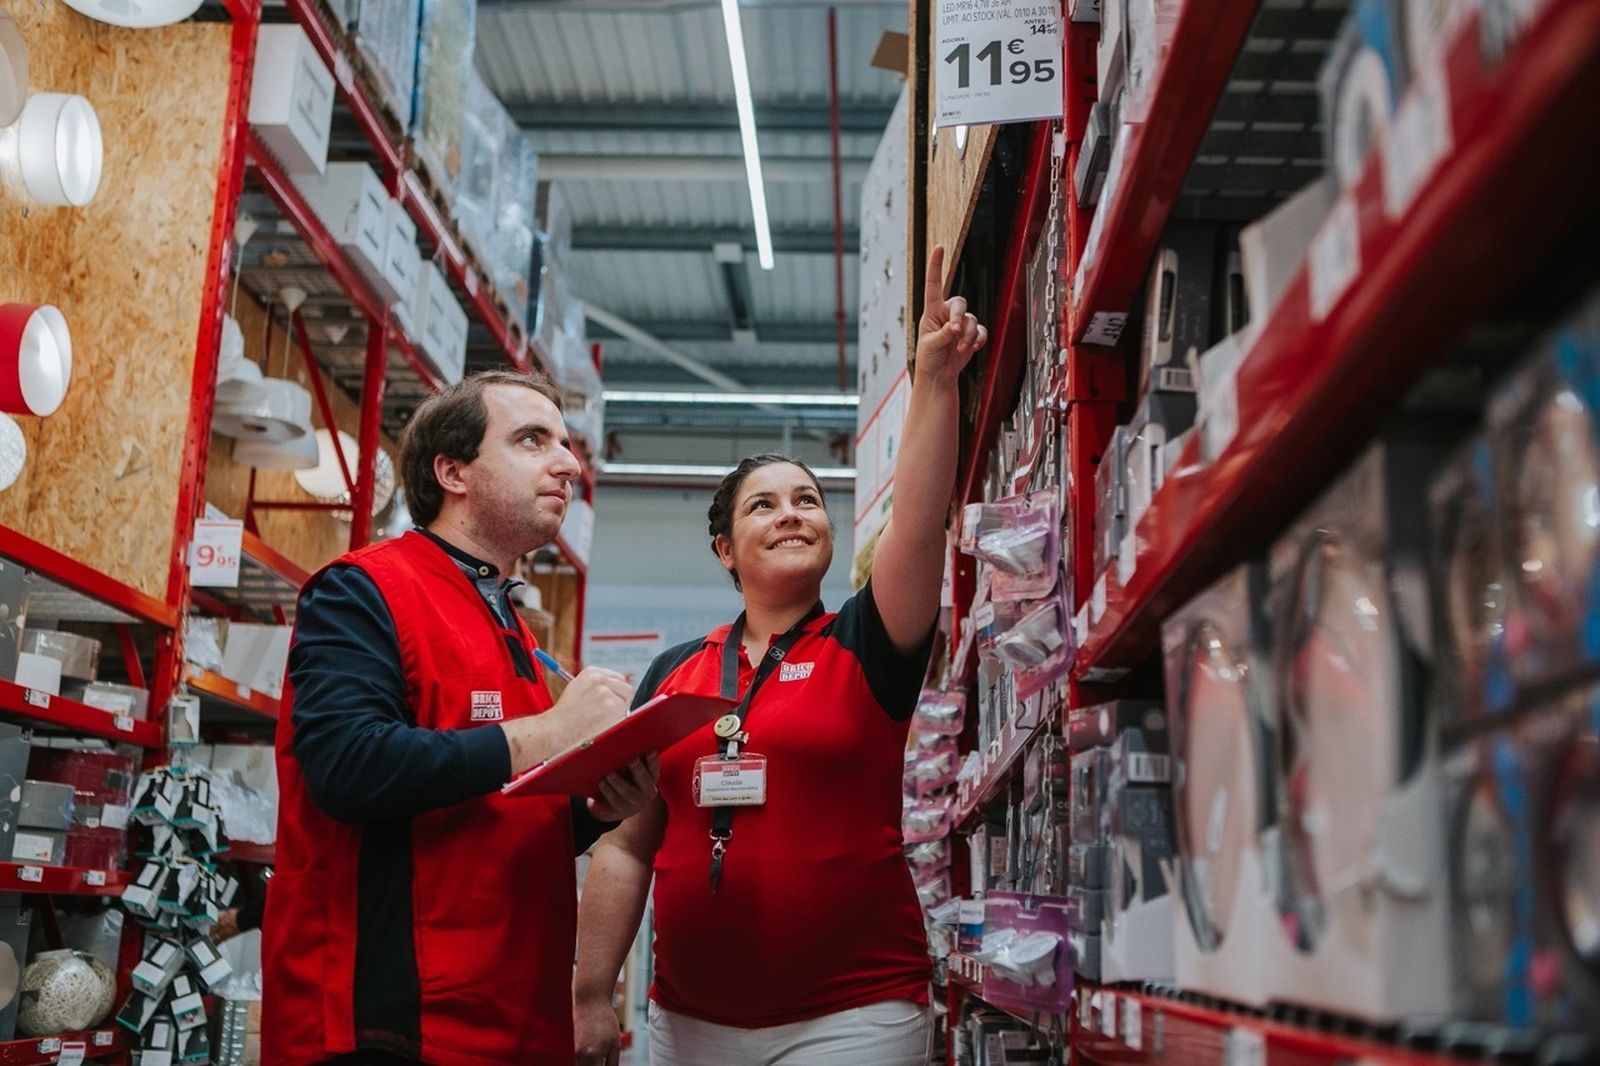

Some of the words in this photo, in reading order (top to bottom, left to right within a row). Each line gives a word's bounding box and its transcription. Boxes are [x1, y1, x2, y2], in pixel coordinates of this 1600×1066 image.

[943, 3, 955, 13] LED
[962, 13, 972, 22] AO
[973, 10, 995, 21] STOCK
[472, 693, 500, 705] BRICO
